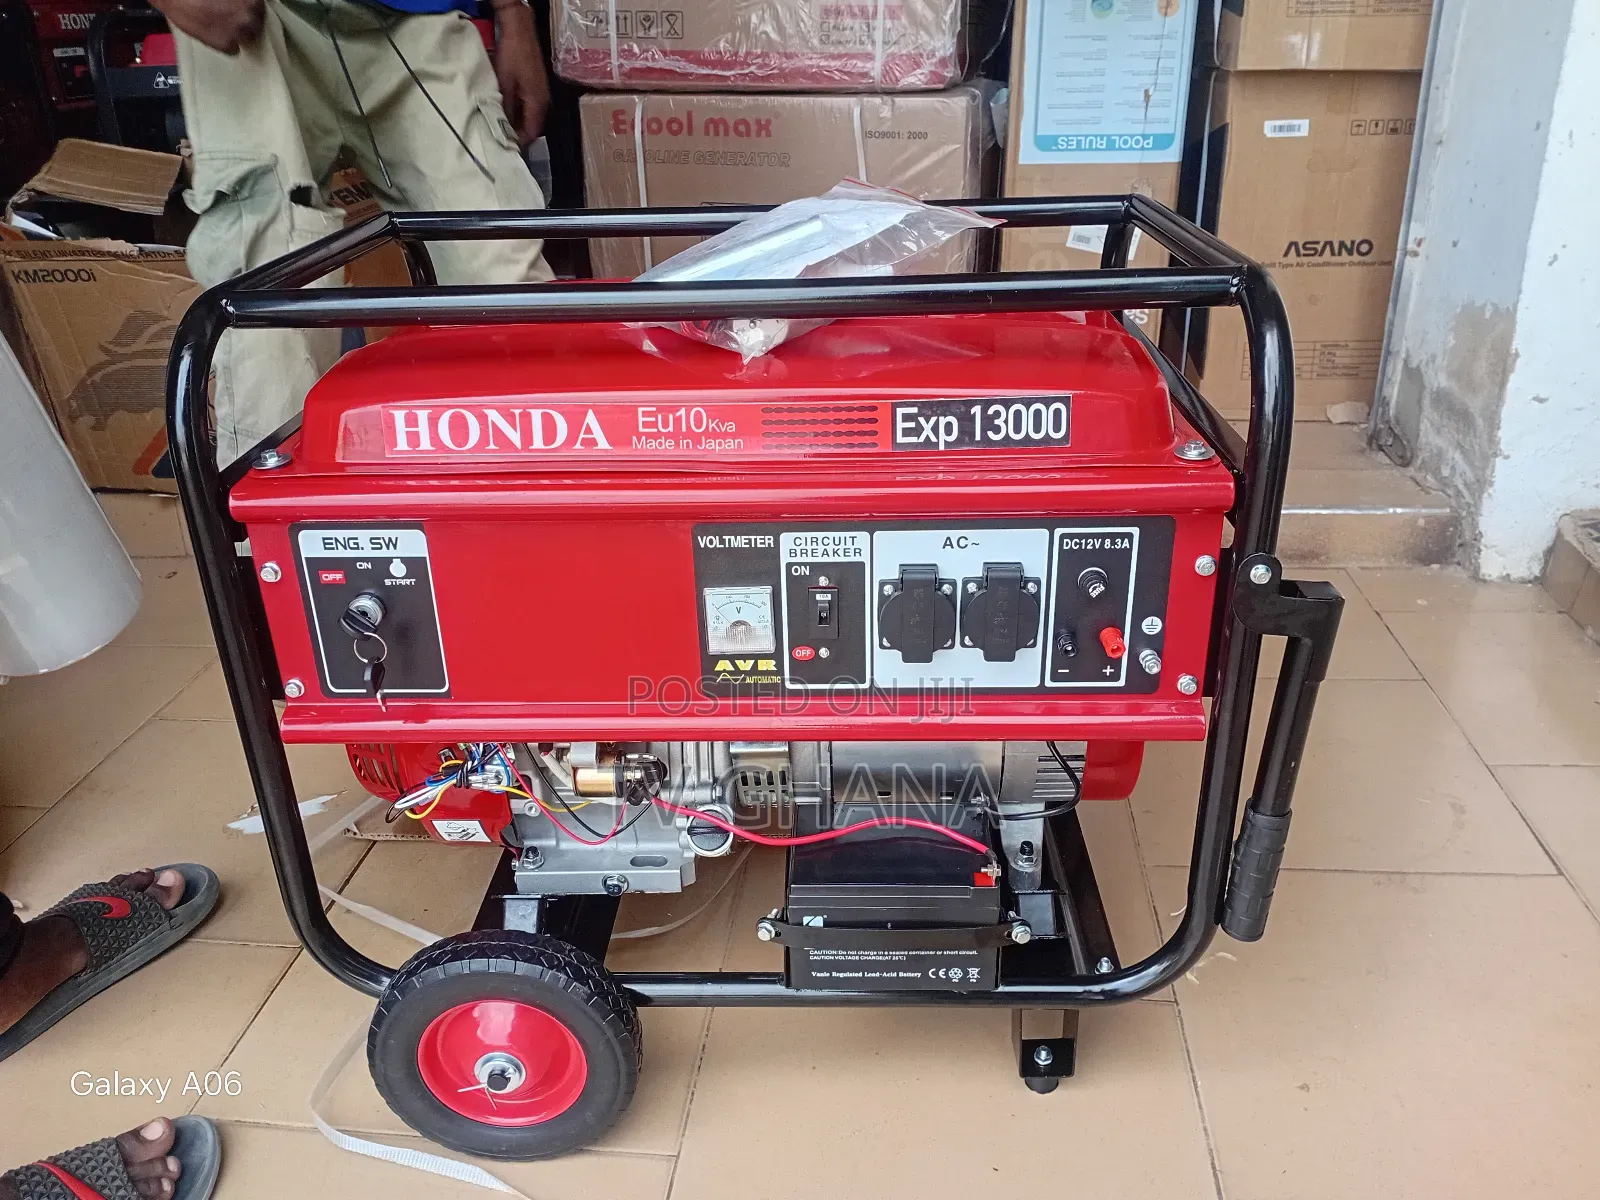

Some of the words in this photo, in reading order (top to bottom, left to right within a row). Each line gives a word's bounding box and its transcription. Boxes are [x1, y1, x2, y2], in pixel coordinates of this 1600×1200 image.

[58, 13, 96, 30] HON
[704, 117, 772, 137] max
[907, 130, 929, 140] 2000
[1111, 135, 1154, 149] POOL
[613, 149, 691, 165] GAOLINE
[693, 151, 791, 167] GENERATOR
[1282, 238, 1374, 257] ASANO
[11, 268, 97, 284] KM2000i
[388, 408, 614, 451] HONDA
[895, 406, 958, 451] Exp
[970, 402, 1067, 442] 13000
[632, 436, 676, 450] Made
[679, 436, 693, 450] in
[696, 436, 744, 452] Japan
[322, 536, 365, 551] ENG.
[369, 536, 399, 551] SW
[697, 535, 774, 548] VOLTMETER
[793, 536, 858, 547] CIRCUIT
[1063, 538, 1102, 550] DC12V
[1103, 537, 1130, 549] 8.3A
[789, 548, 863, 558] BREAKER
[321, 573, 344, 581] OFF
[791, 565, 810, 576] ON
[384, 578, 416, 586] START
[736, 606, 742, 614] V
[795, 649, 812, 657] OFF
[714, 659, 778, 671] AVR
[745, 675, 782, 684] AUTOMATIC
